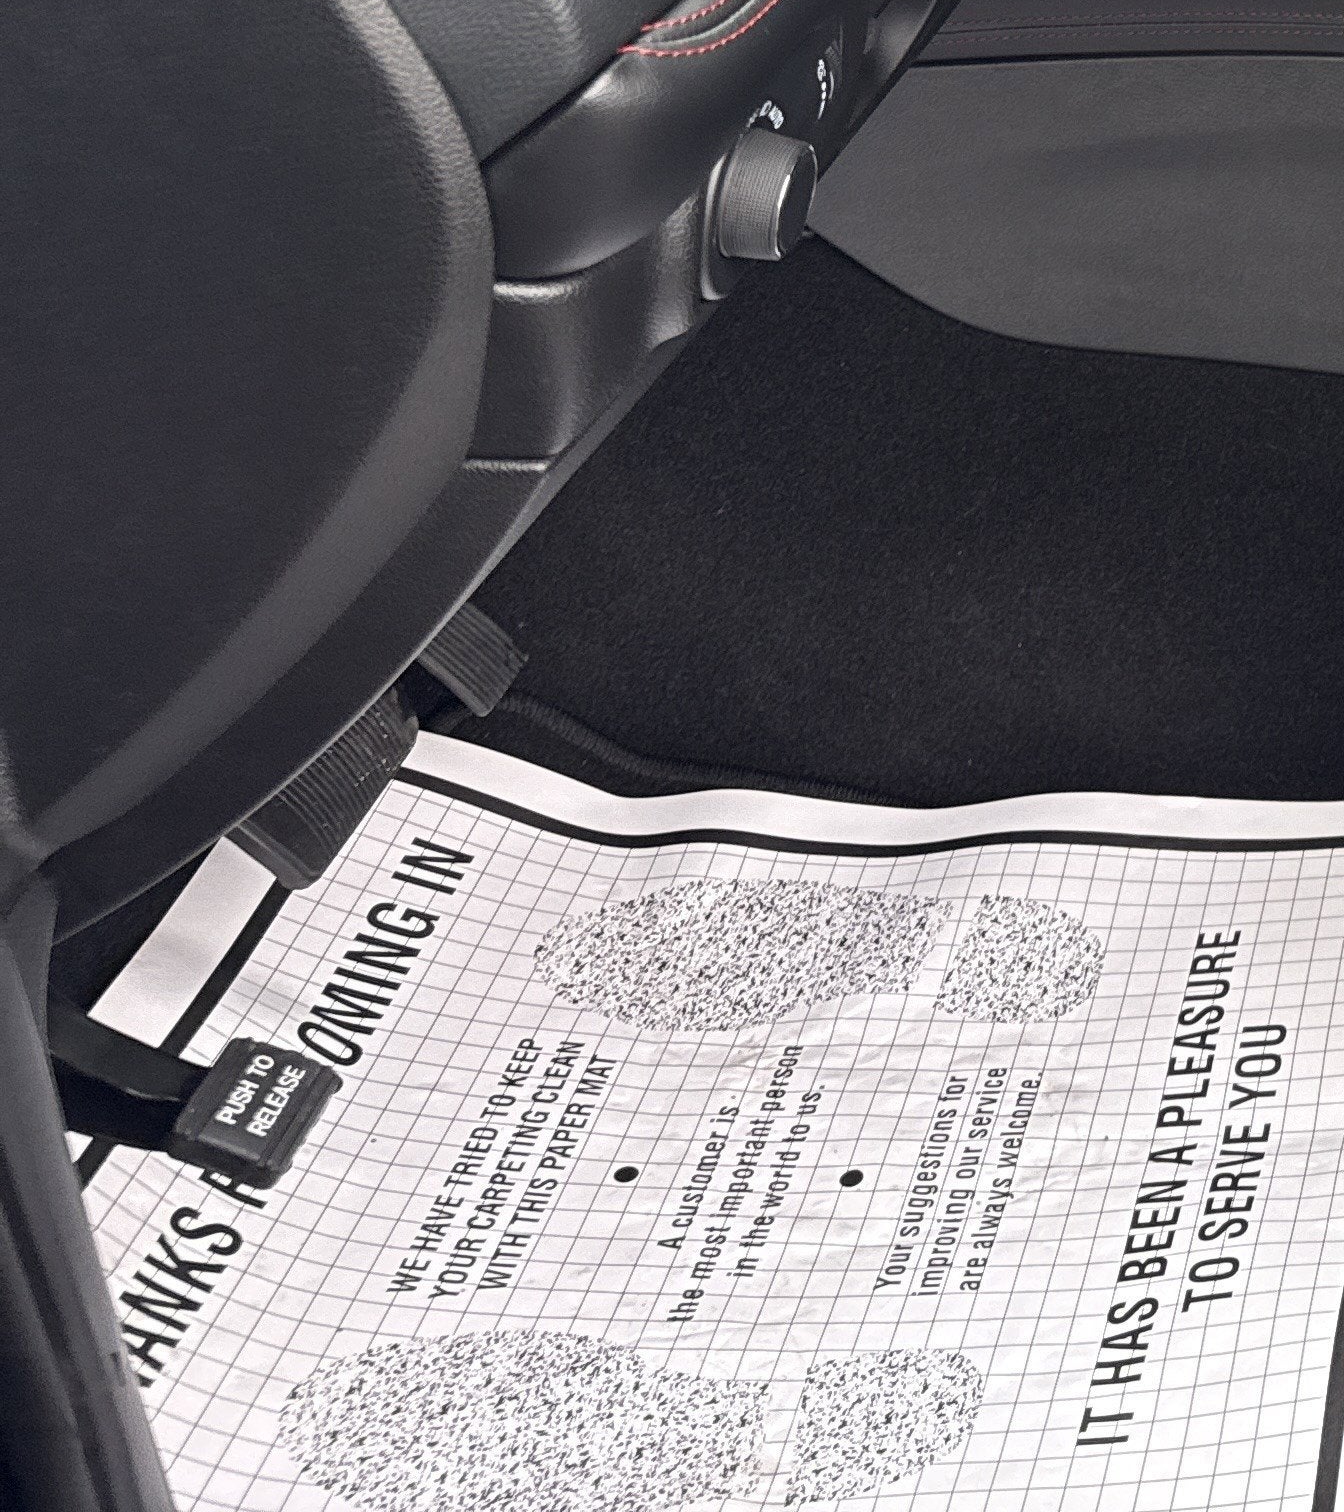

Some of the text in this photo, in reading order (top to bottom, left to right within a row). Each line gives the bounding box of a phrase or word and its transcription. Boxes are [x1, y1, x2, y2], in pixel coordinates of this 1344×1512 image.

[296, 837, 475, 1067] OMING IN
[215, 1080, 259, 1125] PUSH
[245, 1054, 275, 1077] TO
[246, 1065, 306, 1137] RELEASE
[386, 1038, 544, 1292] WE HAVE TRIED TO KEEP
[428, 1040, 585, 1299] YOUR CARPETING CLEAN
[476, 1054, 618, 1289] WITH THIS PAPER MAT
[657, 1236, 685, 1250] A
[673, 1135, 727, 1231] customer
[667, 1044, 803, 1323] the most important person
[726, 1085, 826, 1278] in the world to us.
[874, 1074, 969, 1291] Your suggestions for
[911, 1067, 1008, 1296] improving our service
[960, 1072, 1043, 1291] are always welcome.
[1076, 929, 1243, 1446] IT HAS BEEN A PLEASURE
[1182, 1023, 1288, 1313] TO SERVE YOU
